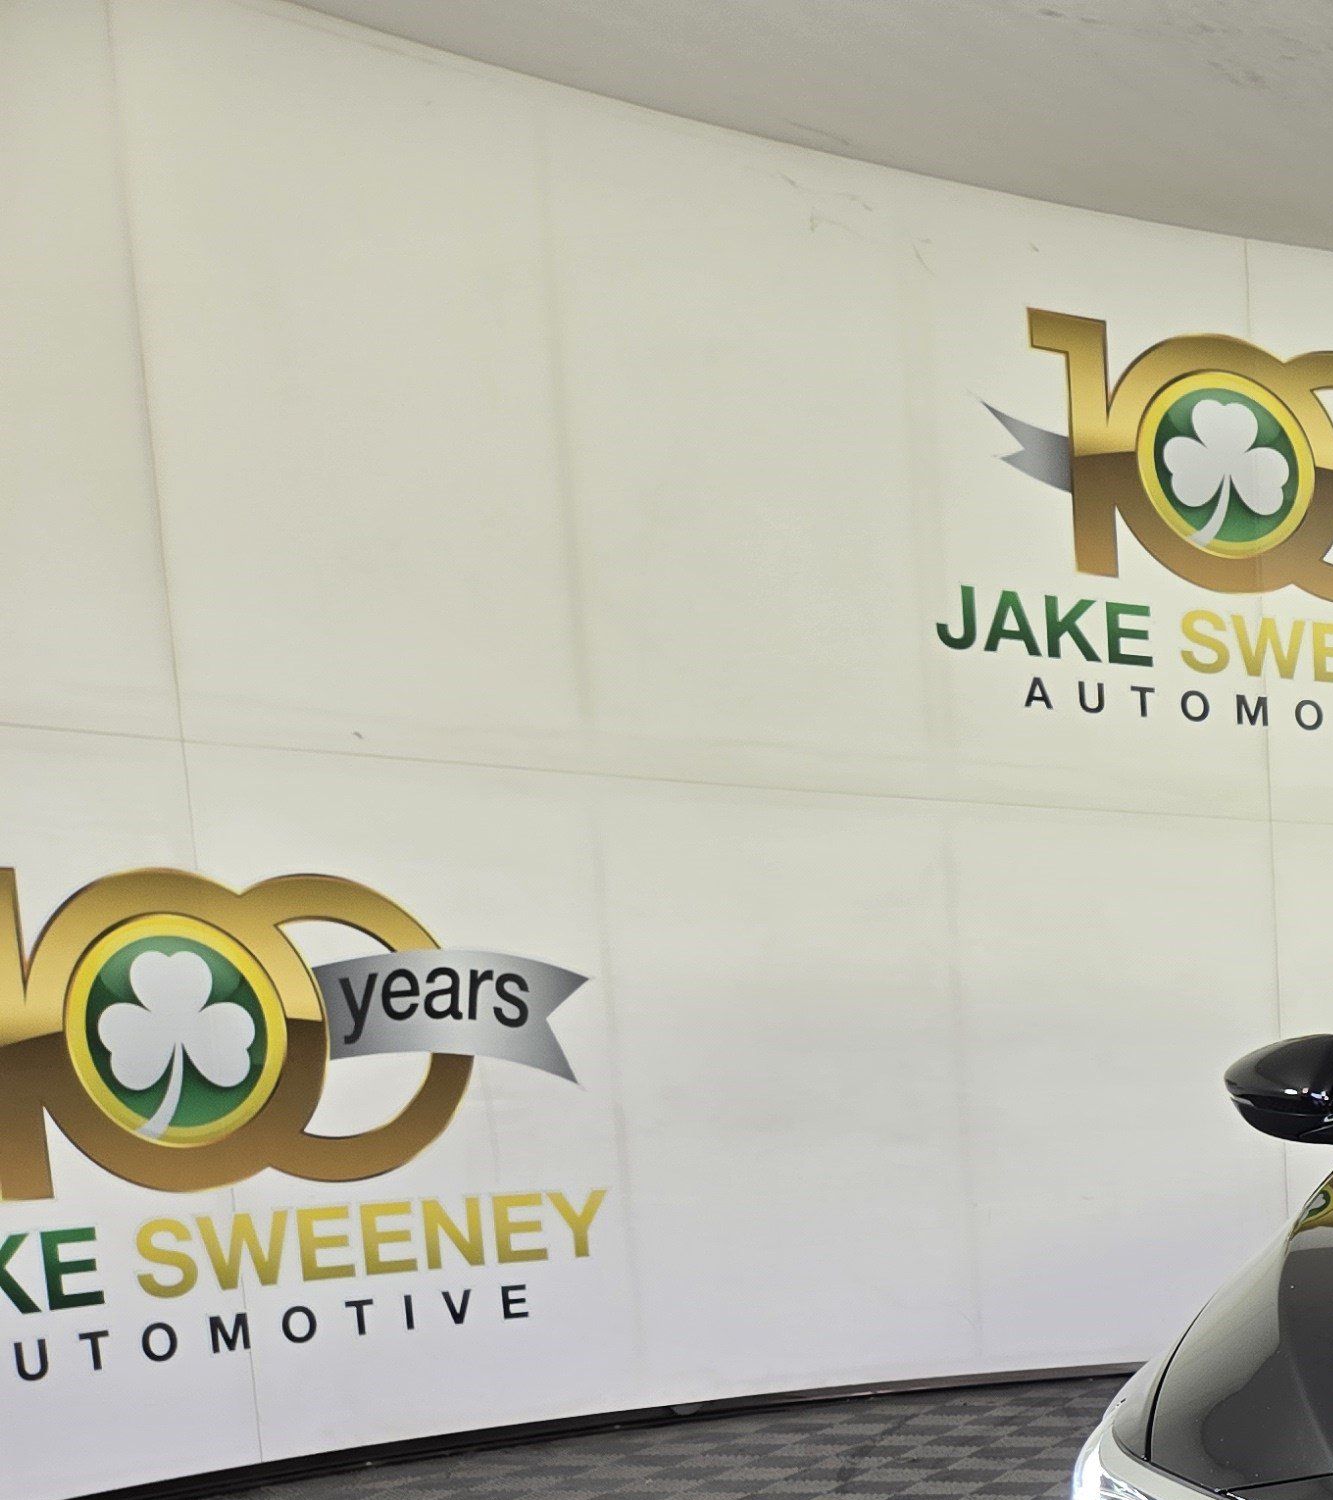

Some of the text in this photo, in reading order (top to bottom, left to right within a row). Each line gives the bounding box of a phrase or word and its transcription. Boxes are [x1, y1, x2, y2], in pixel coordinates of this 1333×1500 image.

[936, 585, 1153, 667] JAKE
[339, 966, 529, 1044] years
[135, 1189, 607, 1298] SWEENEY
